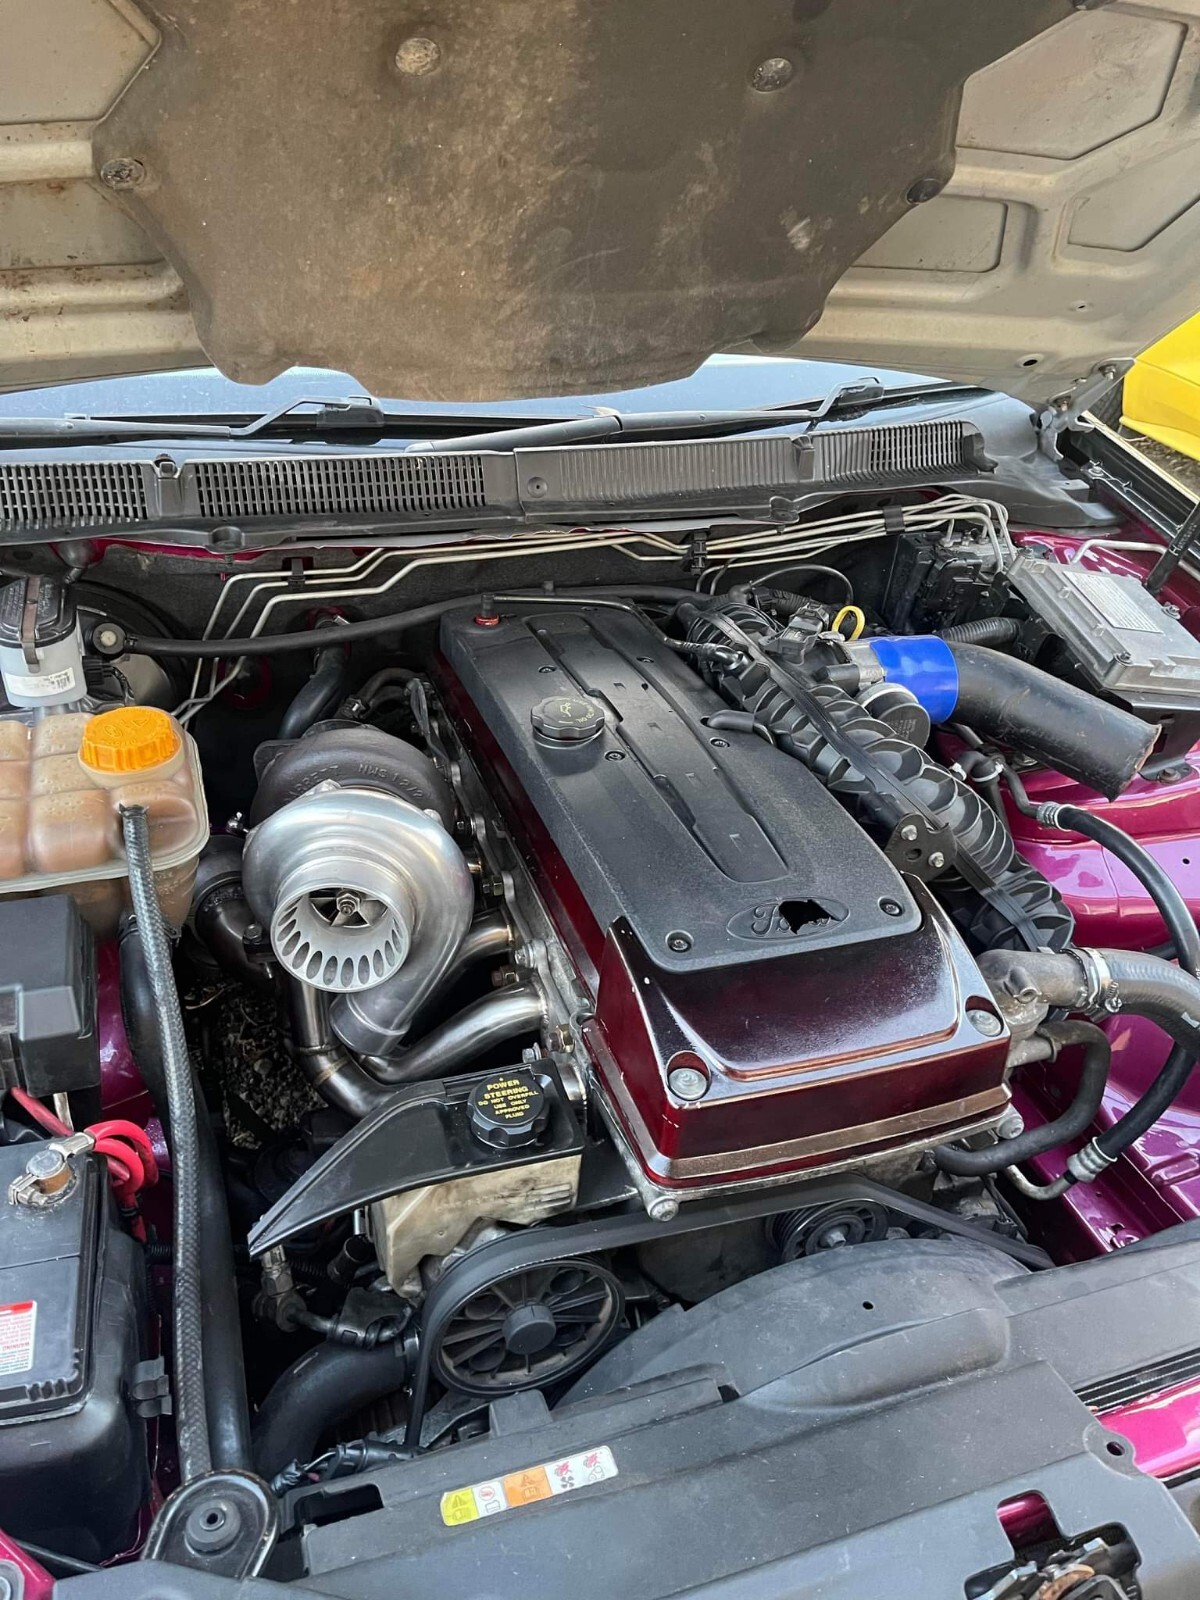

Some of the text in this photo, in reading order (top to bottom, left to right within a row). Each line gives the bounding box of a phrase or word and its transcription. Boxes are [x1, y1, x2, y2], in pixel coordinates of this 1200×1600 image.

[486, 1080, 520, 1091] POWER
[484, 1086, 529, 1100] STEERING
[507, 1090, 539, 1101] OVERFILL
[495, 1104, 530, 1115] APPROVED
